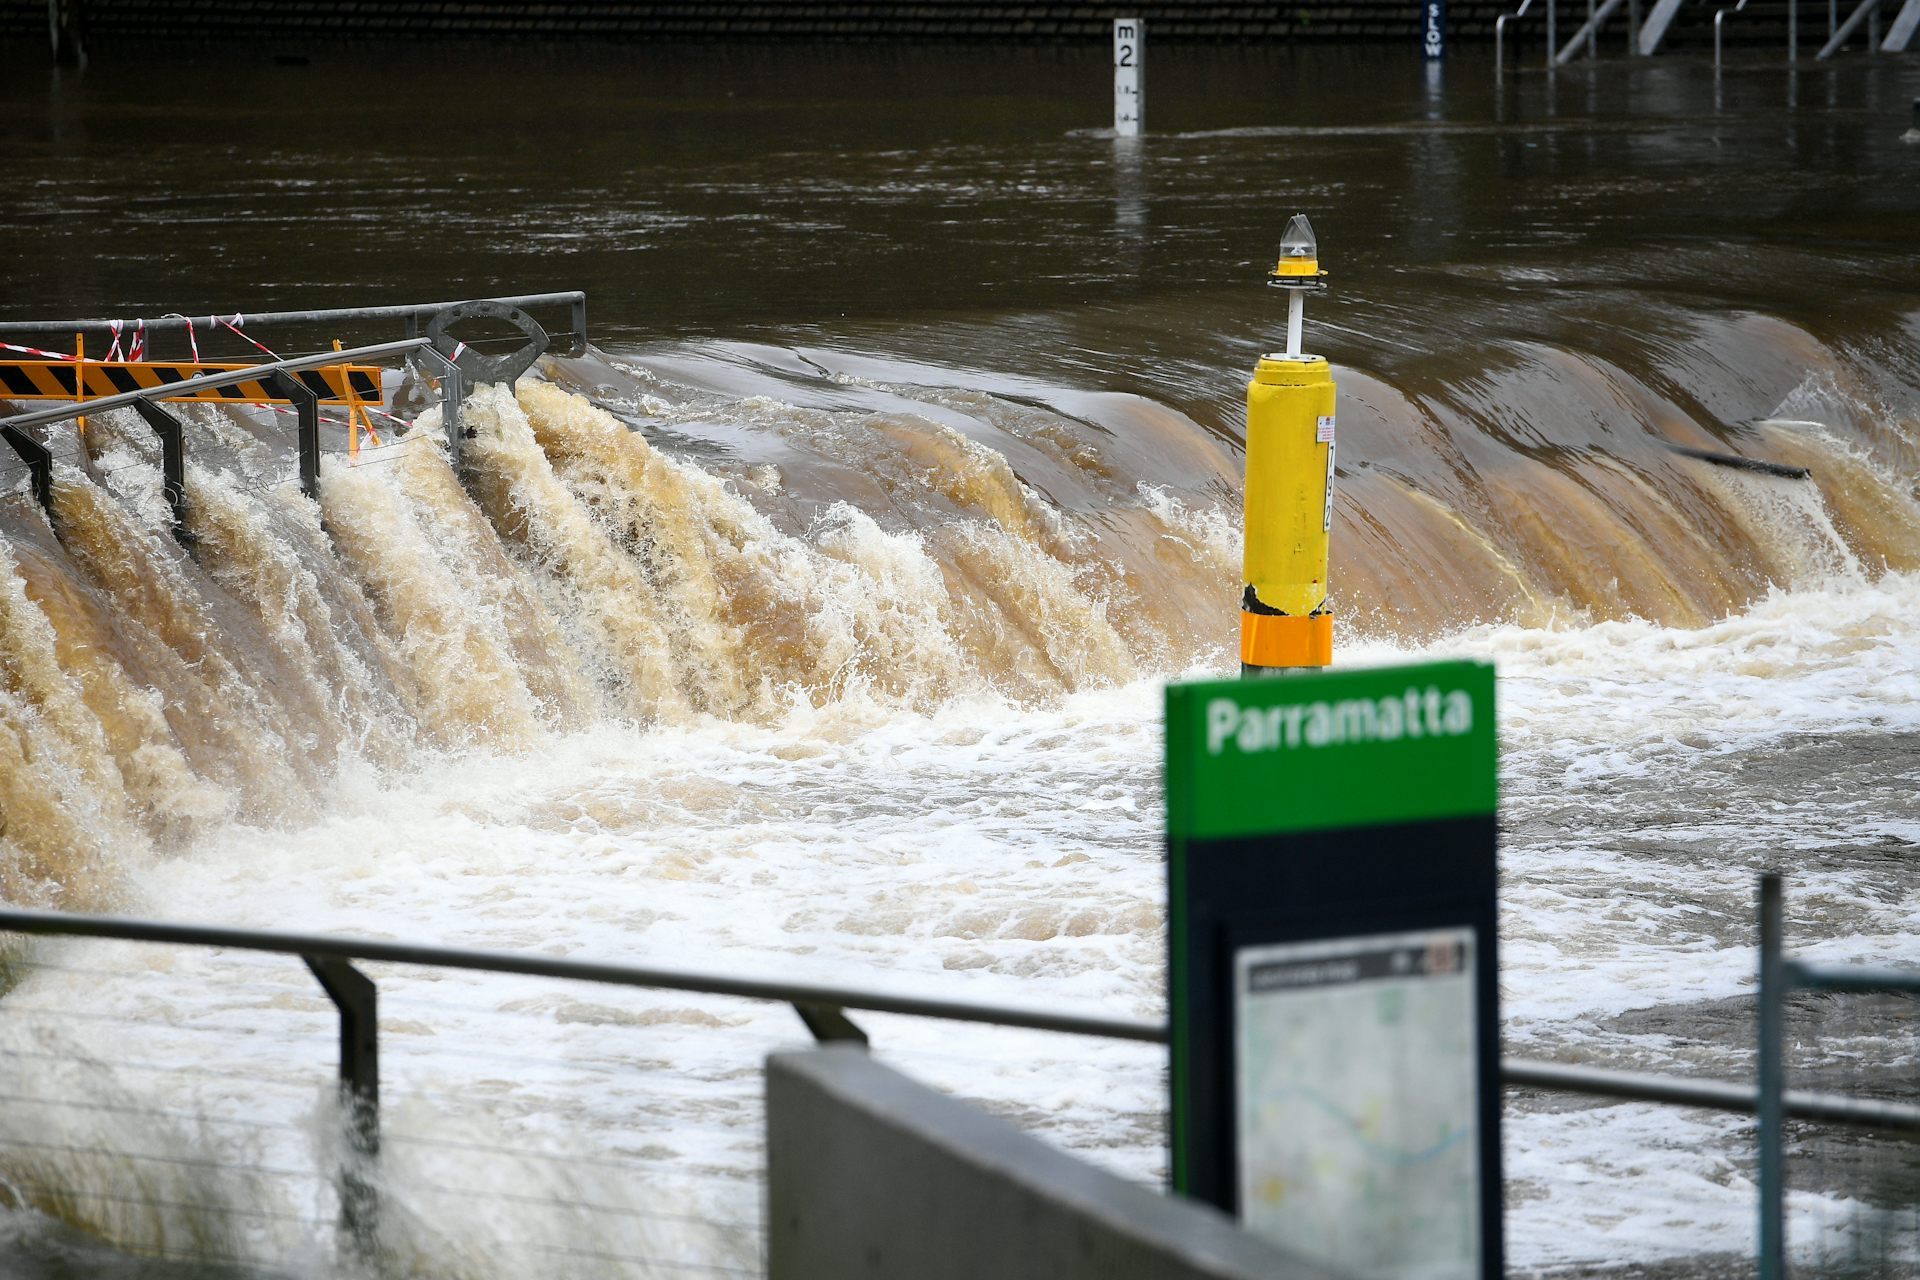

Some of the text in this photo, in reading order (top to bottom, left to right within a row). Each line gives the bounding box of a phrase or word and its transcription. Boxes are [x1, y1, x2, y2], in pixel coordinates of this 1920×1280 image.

[1118, 26, 1134, 39] m
[1120, 45, 1132, 67] 2
[1425, 3, 1442, 56] SLOW
[1325, 445, 1334, 527] 792
[1207, 687, 1473, 754] Parramatta
